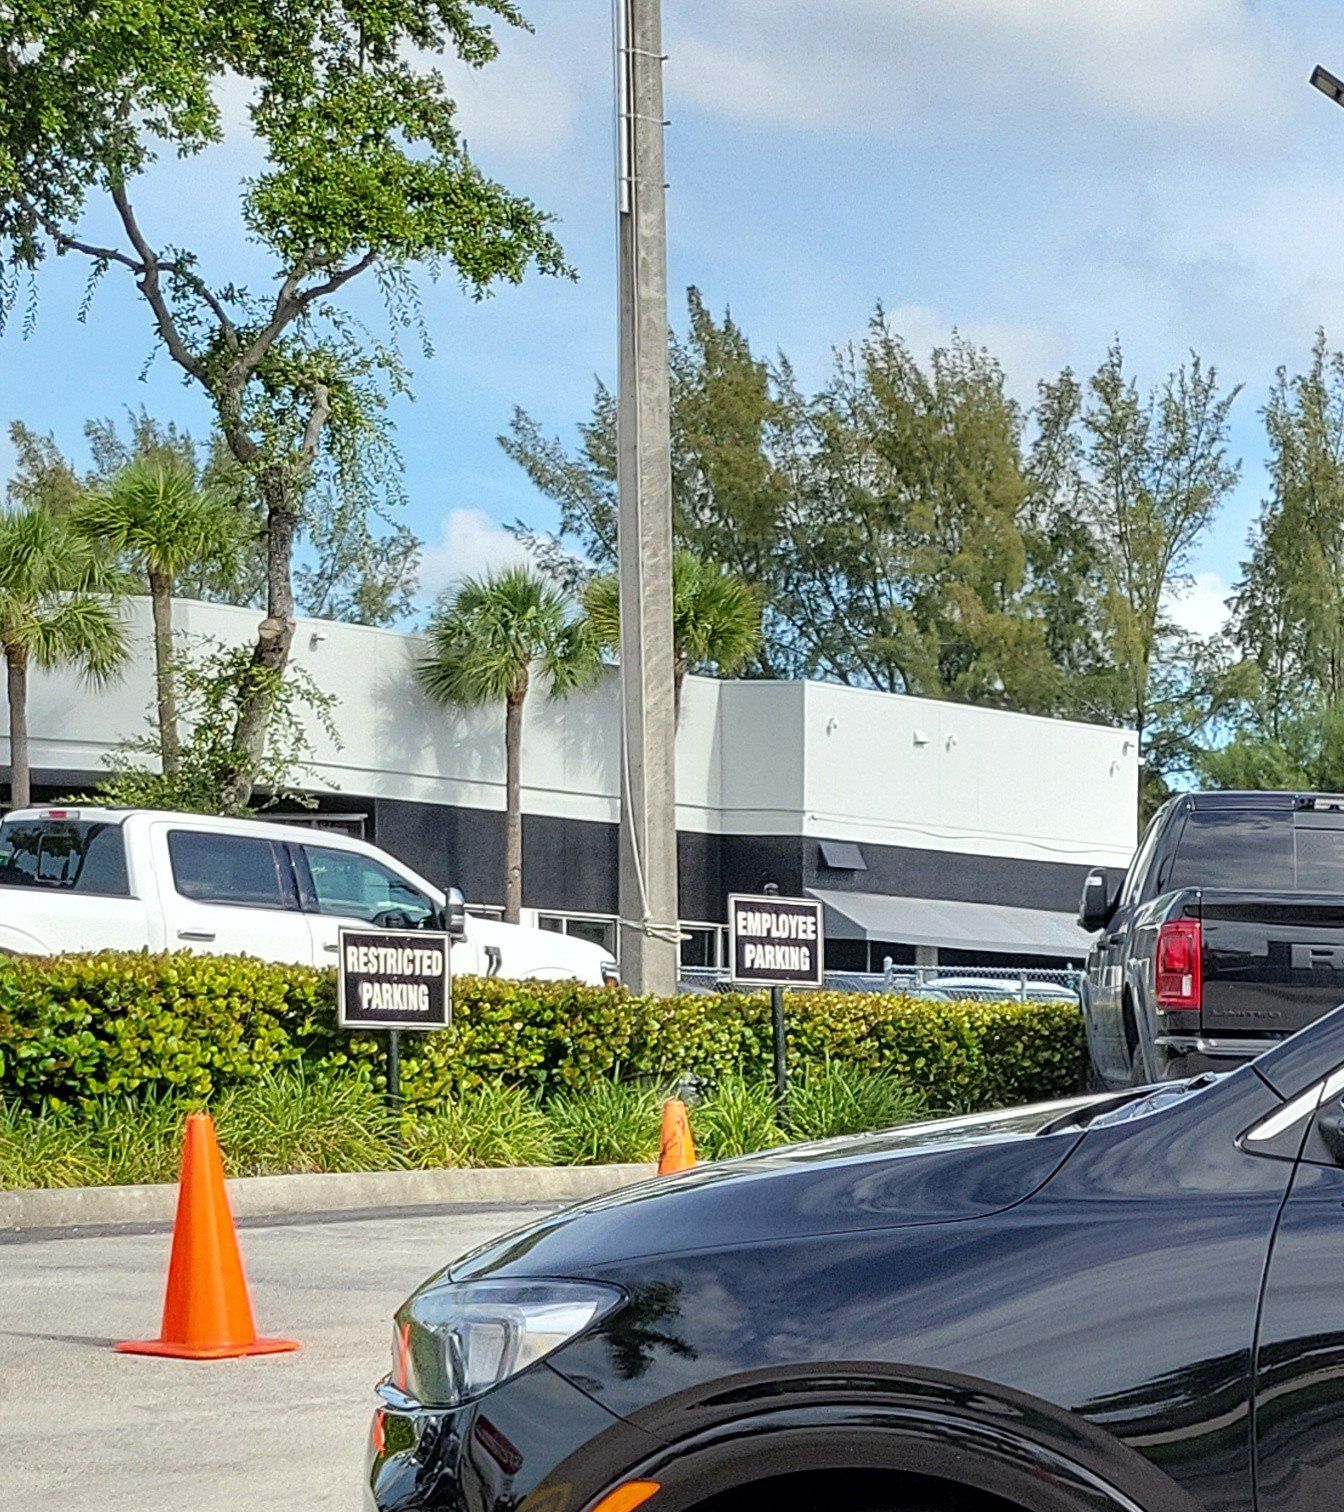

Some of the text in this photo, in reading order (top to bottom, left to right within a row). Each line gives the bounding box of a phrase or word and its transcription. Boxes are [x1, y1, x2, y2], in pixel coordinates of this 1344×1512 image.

[736, 911, 817, 940] EMPLOYEE
[346, 945, 443, 977] RESTRICTED
[744, 943, 811, 971] PARKING
[361, 981, 430, 1012] PARKING
